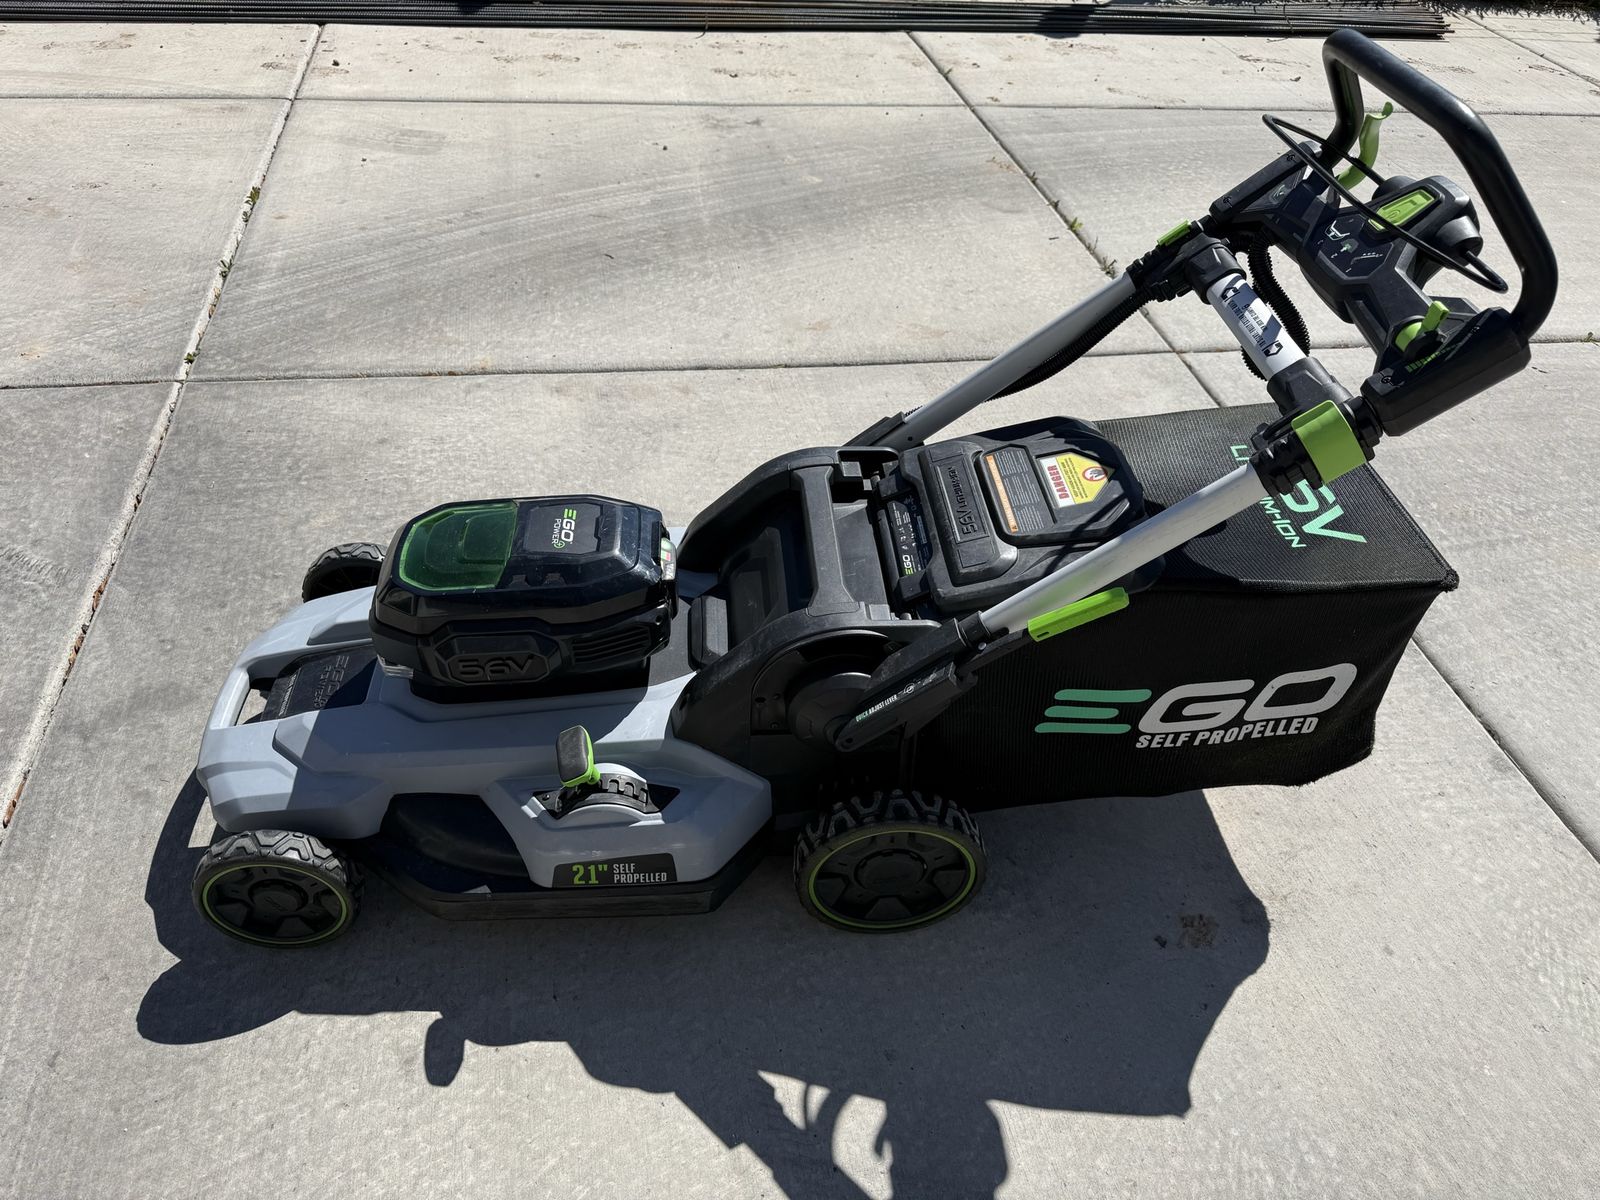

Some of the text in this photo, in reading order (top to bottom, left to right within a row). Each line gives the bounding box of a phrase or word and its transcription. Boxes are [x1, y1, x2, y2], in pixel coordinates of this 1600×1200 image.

[1047, 464, 1070, 500] DANGER
[562, 508, 577, 544] EGO
[902, 554, 913, 575] EGO
[457, 654, 535, 680] 56V
[1035, 663, 1357, 734] EGO
[1136, 717, 1319, 749] SELF PROPELLED
[571, 864, 608, 885] 21"
[613, 863, 636, 874] SELF
[614, 872, 667, 884] PROPELLED
